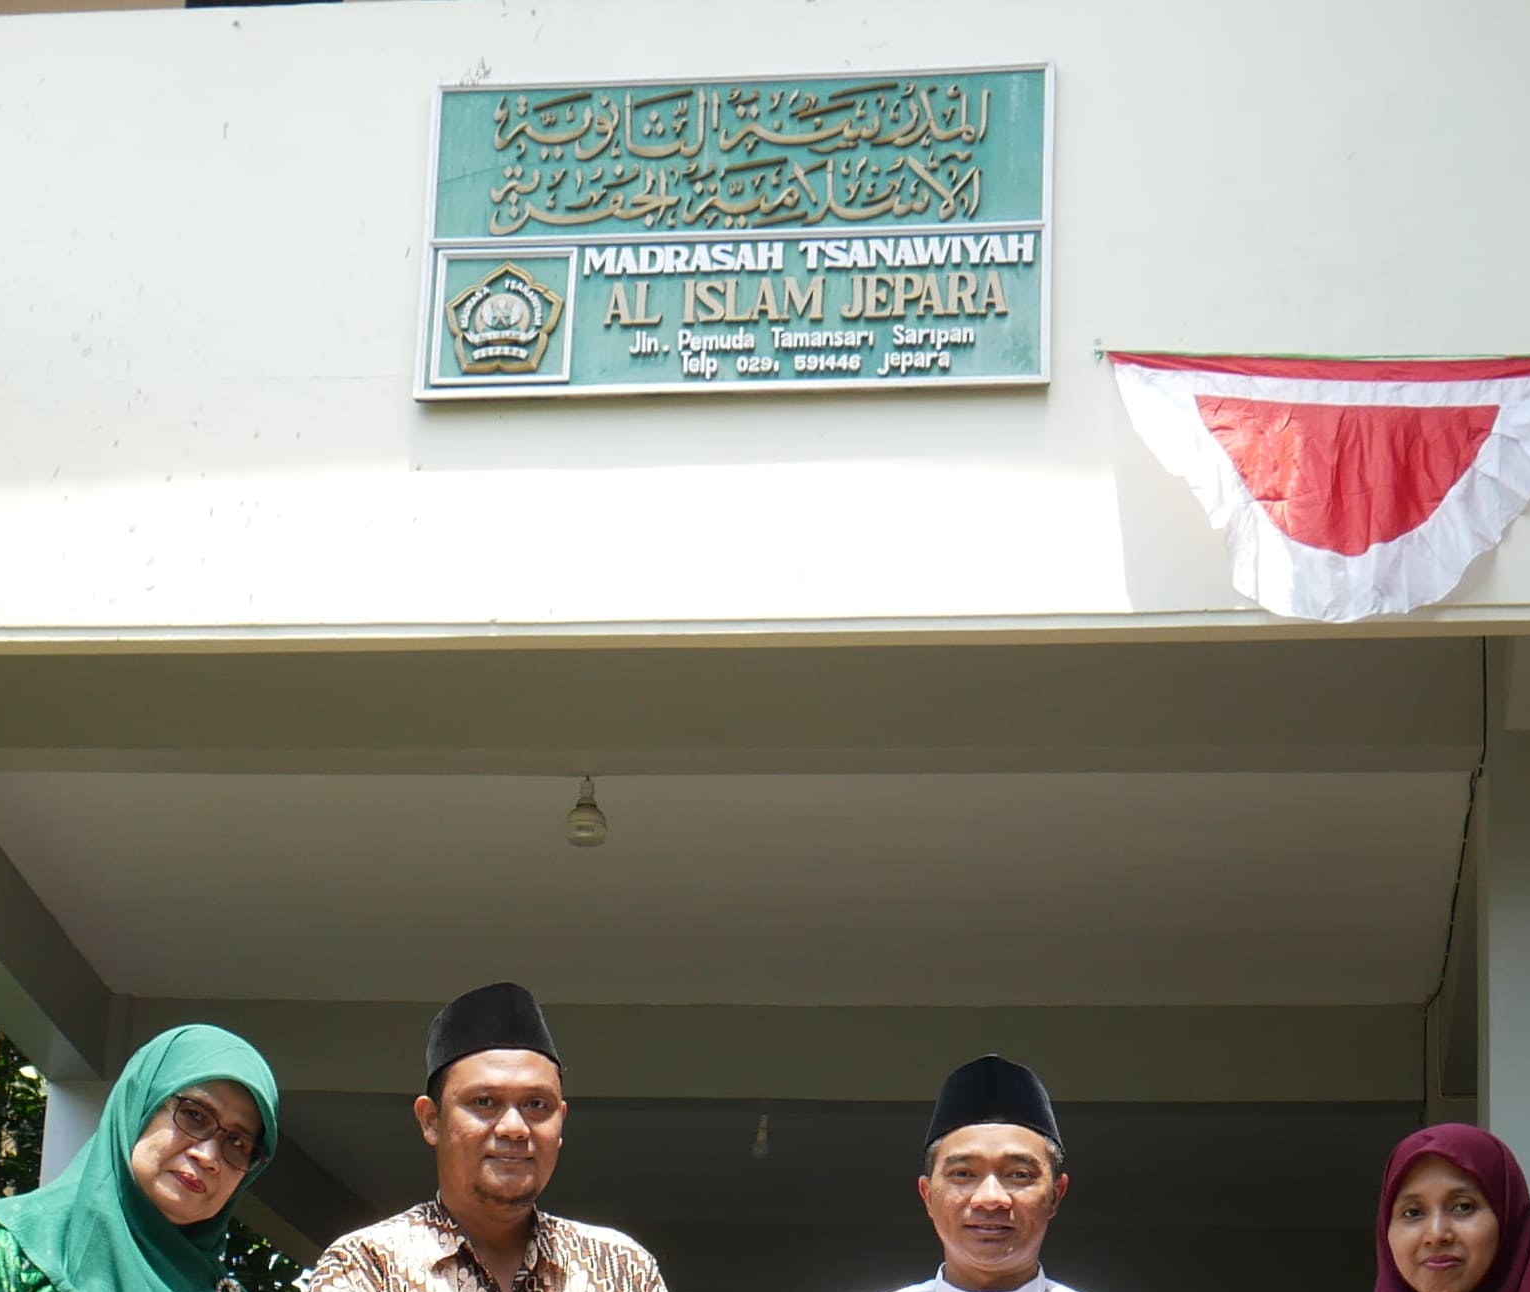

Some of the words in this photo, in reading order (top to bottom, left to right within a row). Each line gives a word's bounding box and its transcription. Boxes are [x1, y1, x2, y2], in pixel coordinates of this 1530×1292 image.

[583, 241, 785, 276] MADRASAH
[799, 233, 1036, 270] TSANAWIYAH
[604, 281, 662, 326] AL
[682, 275, 826, 324] ISLAM
[840, 271, 1009, 320] JEPARA
[629, 330, 669, 354] Jln.
[678, 327, 755, 352] Pemuda
[771, 327, 874, 349] Tamansari
[892, 324, 975, 350] Saripan
[681, 351, 718, 380] Telp
[794, 354, 861, 372] 591446
